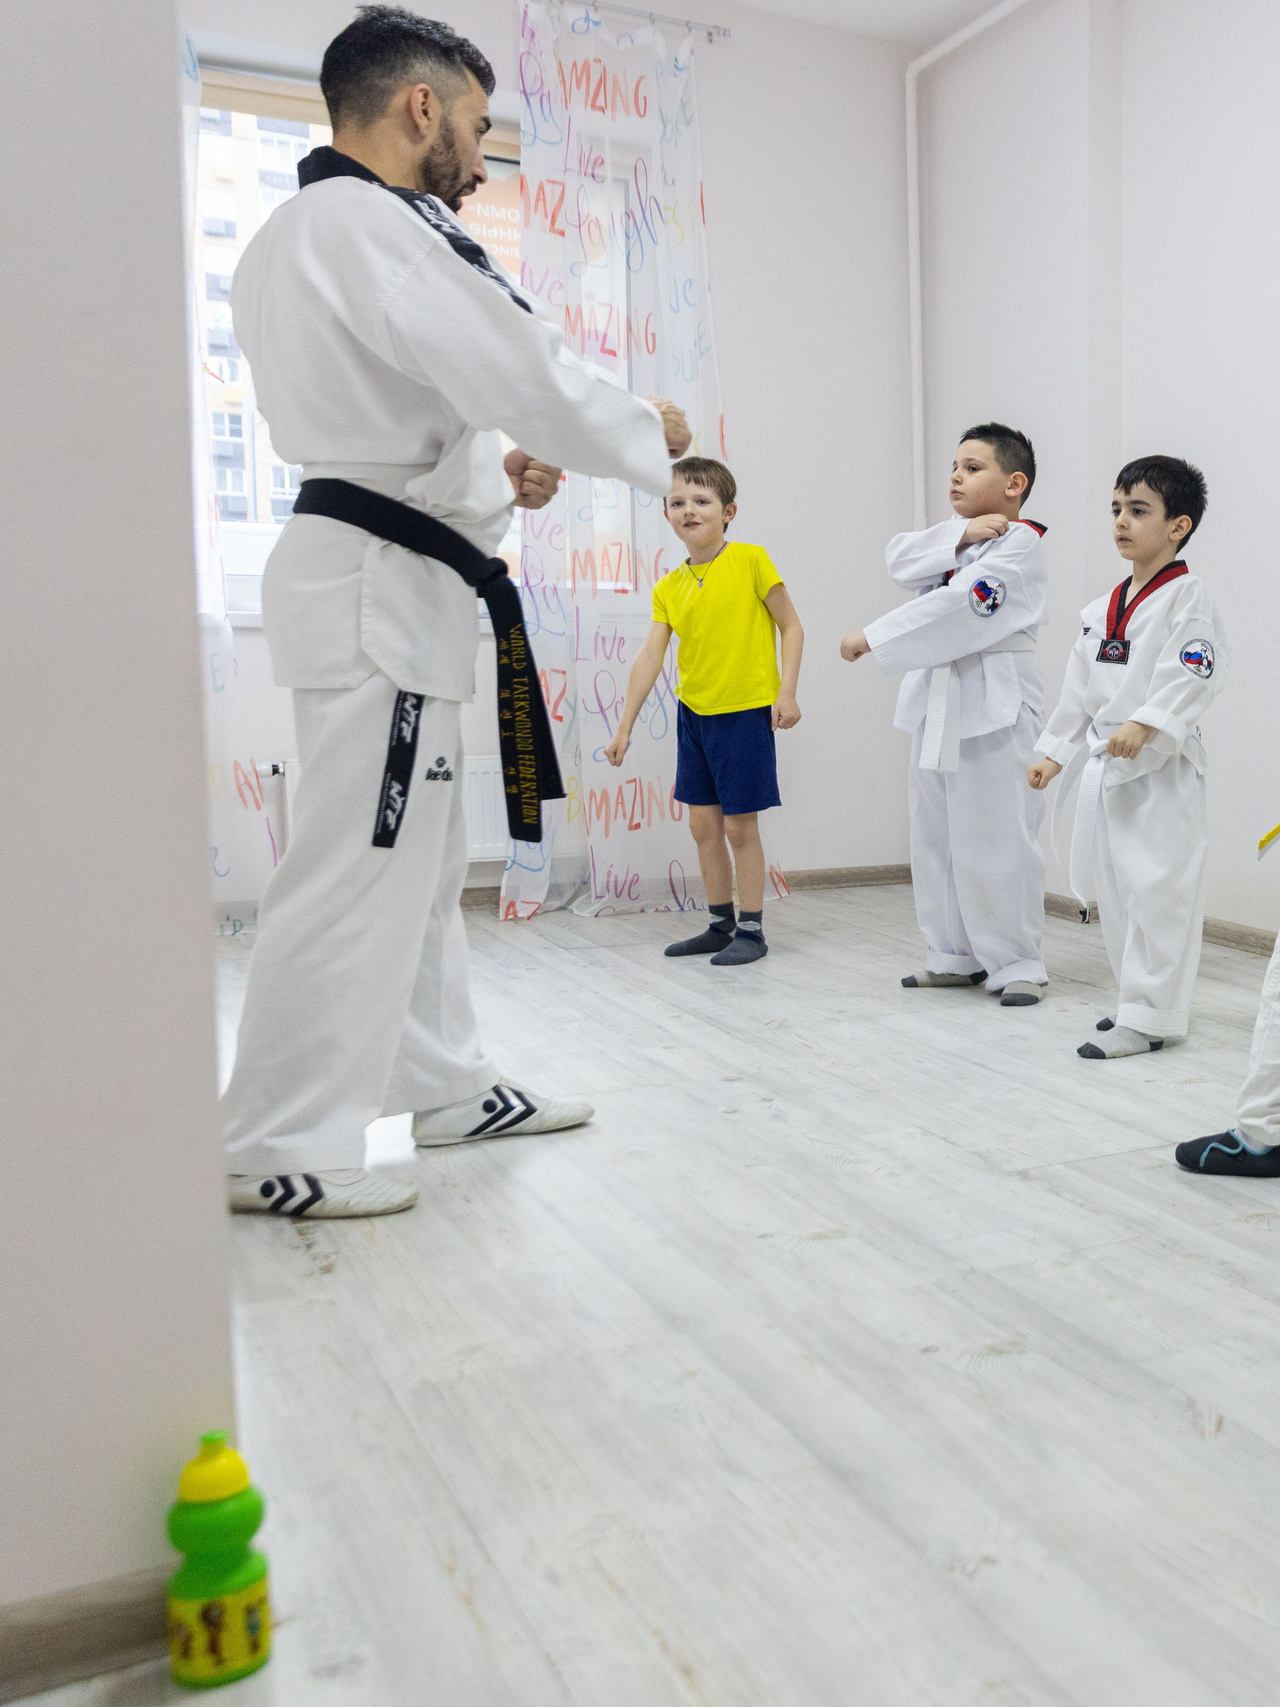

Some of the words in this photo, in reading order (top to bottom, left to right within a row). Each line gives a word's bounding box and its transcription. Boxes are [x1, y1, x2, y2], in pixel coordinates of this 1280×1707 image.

[563, 115, 605, 184] Live
[510, 623, 527, 669] WORLD
[575, 605, 627, 664] Live
[513, 676, 534, 751] TAEKWONDO
[518, 754, 538, 825] FEDERATION
[588, 845, 640, 901] Live
